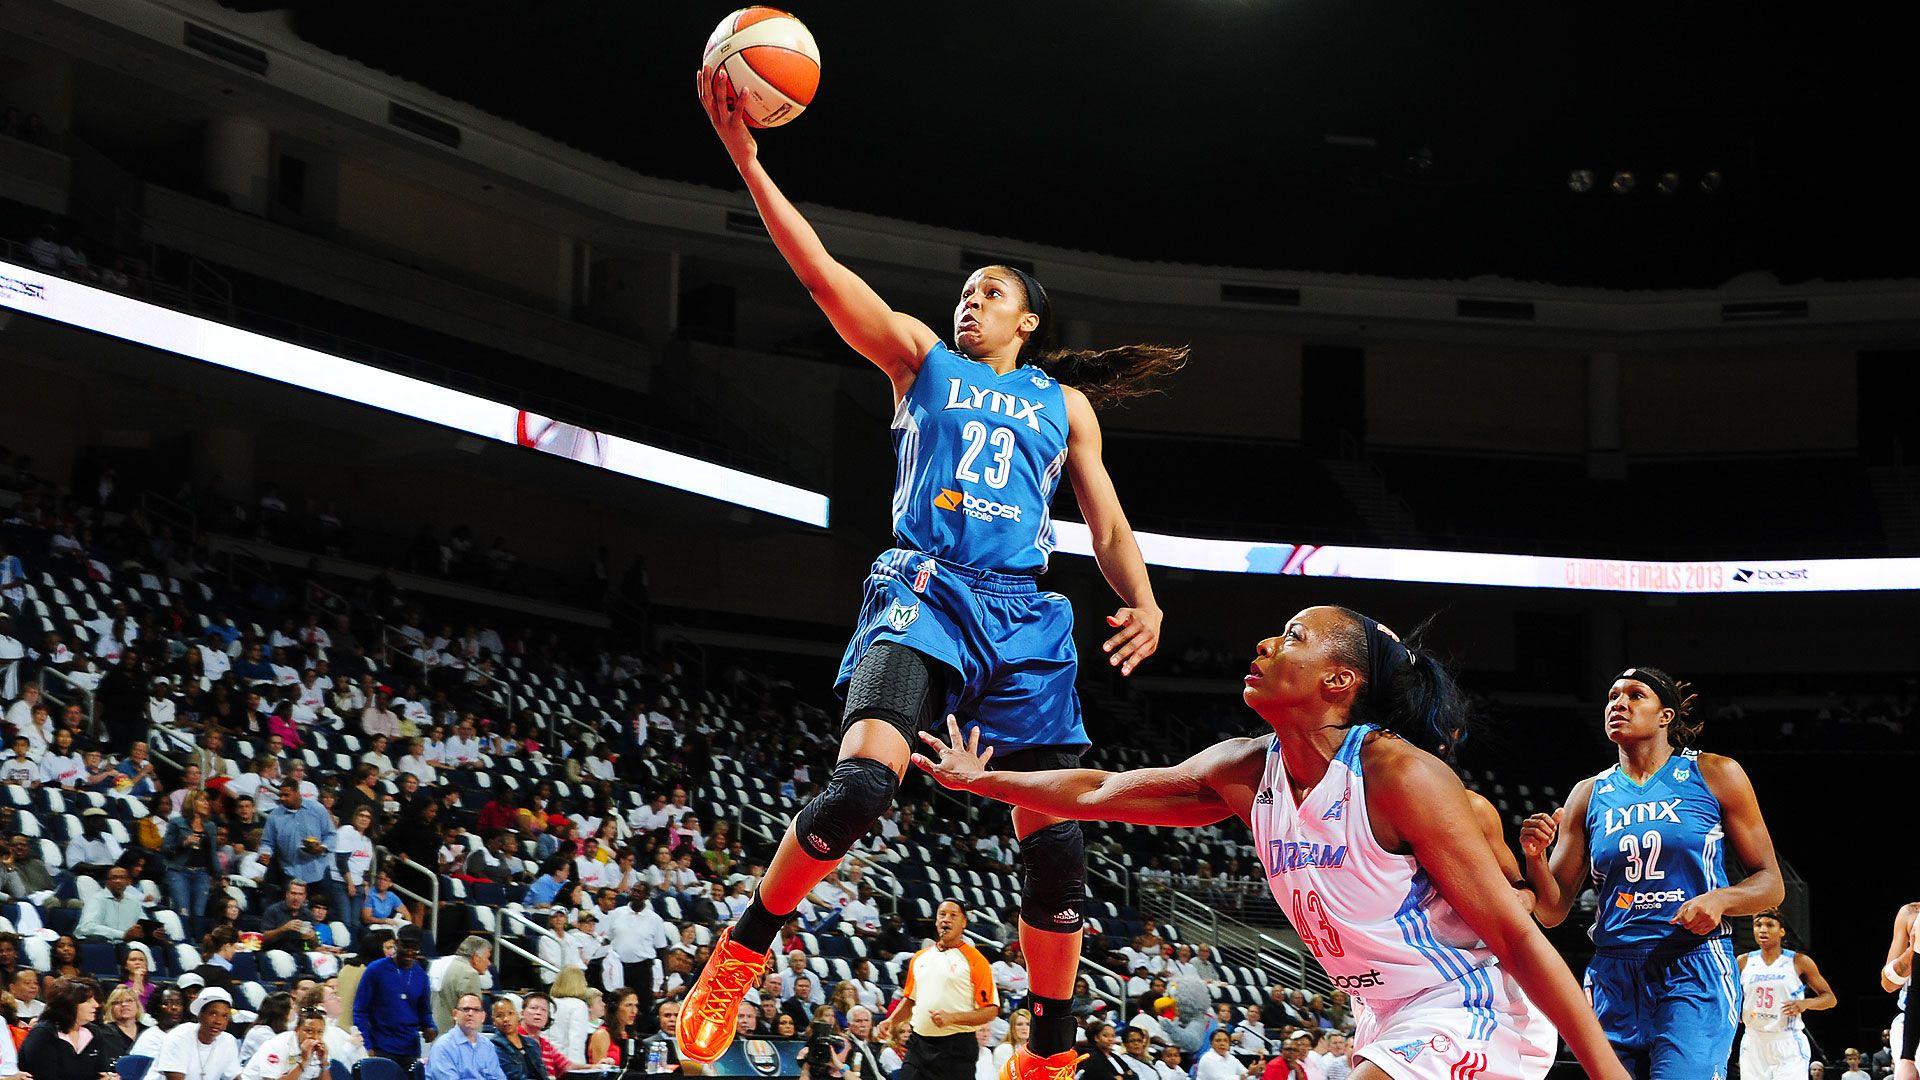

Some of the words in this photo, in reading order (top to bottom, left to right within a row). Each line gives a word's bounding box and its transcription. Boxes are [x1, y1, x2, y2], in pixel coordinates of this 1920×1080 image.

[942, 378, 1046, 434] LYNX
[955, 420, 1016, 489] 23
[962, 491, 1022, 523] boost
[962, 507, 993, 523] mobile
[1686, 565, 1723, 589] 2013
[1758, 569, 1808, 580] boost
[1605, 798, 1684, 837] LYNX
[1268, 840, 1348, 878] DREAM
[1619, 830, 1665, 883] 32
[1633, 888, 1685, 904] boost
[1292, 889, 1345, 958] 43
[1755, 986, 1774, 1009] 35
